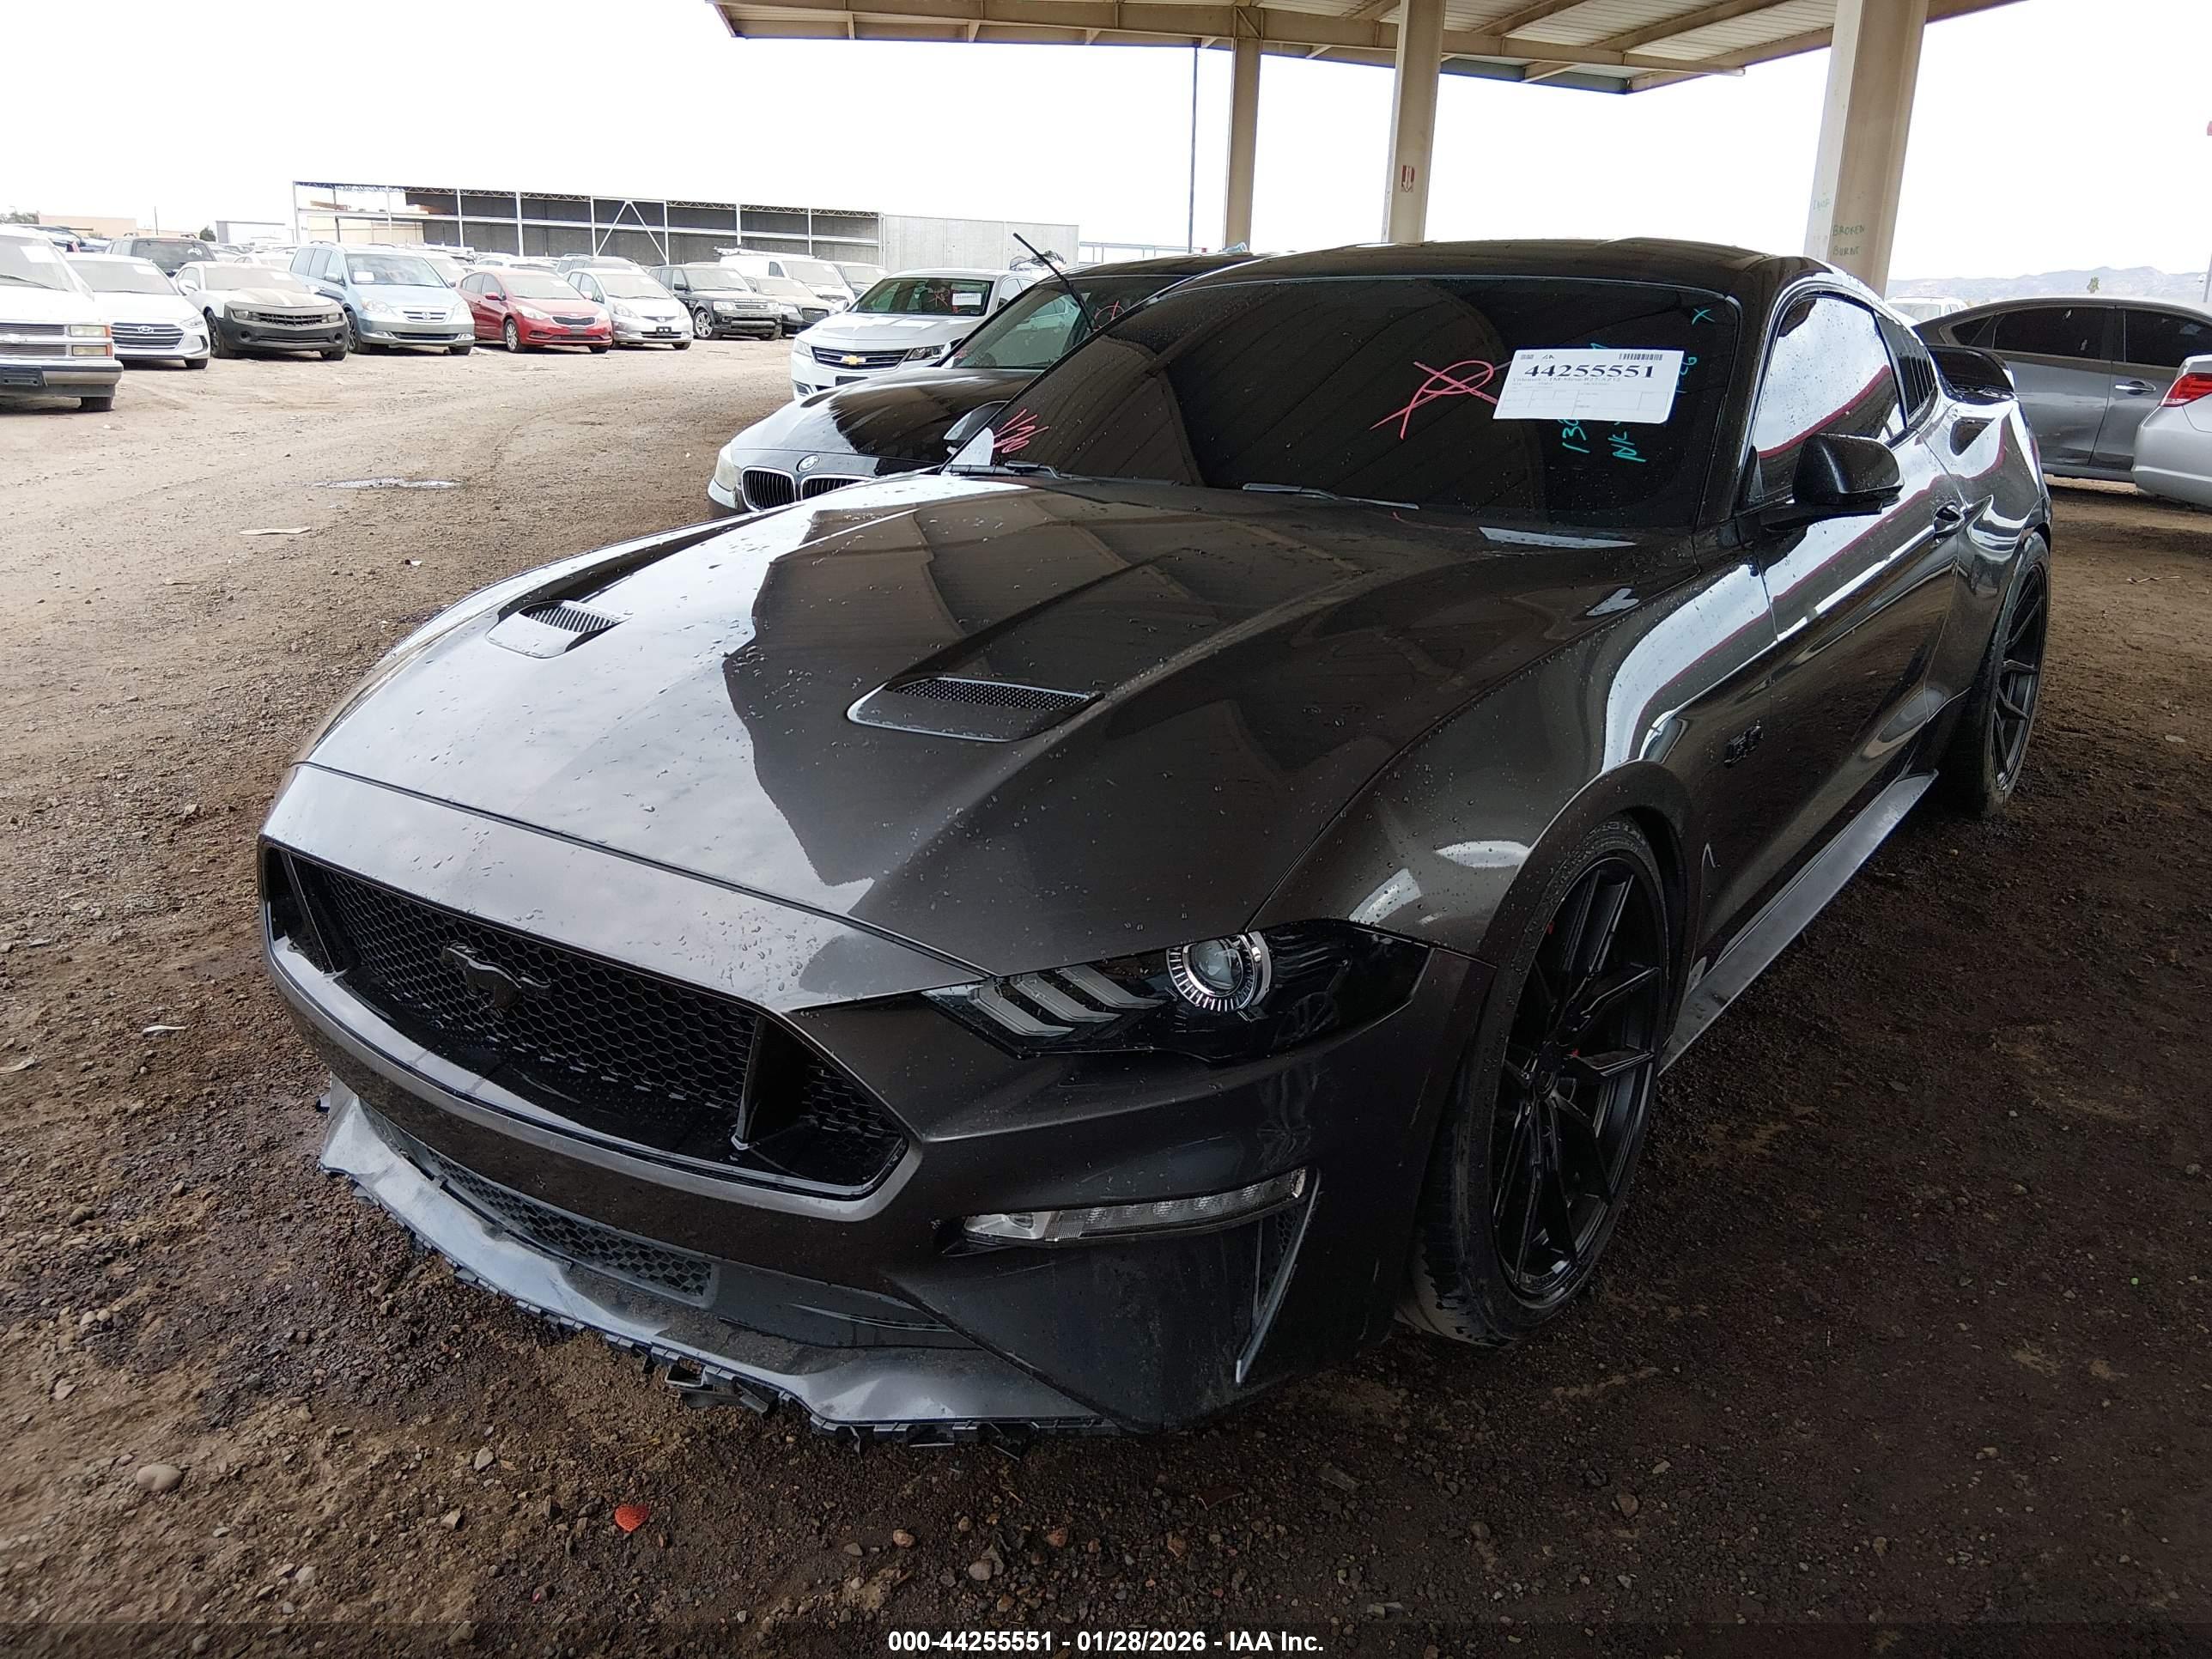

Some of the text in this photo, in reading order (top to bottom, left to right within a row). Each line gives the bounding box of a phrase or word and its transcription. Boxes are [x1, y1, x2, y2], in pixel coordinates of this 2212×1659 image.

[1832, 224, 1865, 237] BROKEN
[1832, 245, 1861, 256] BURNT
[1525, 363, 1655, 379] 44255551
